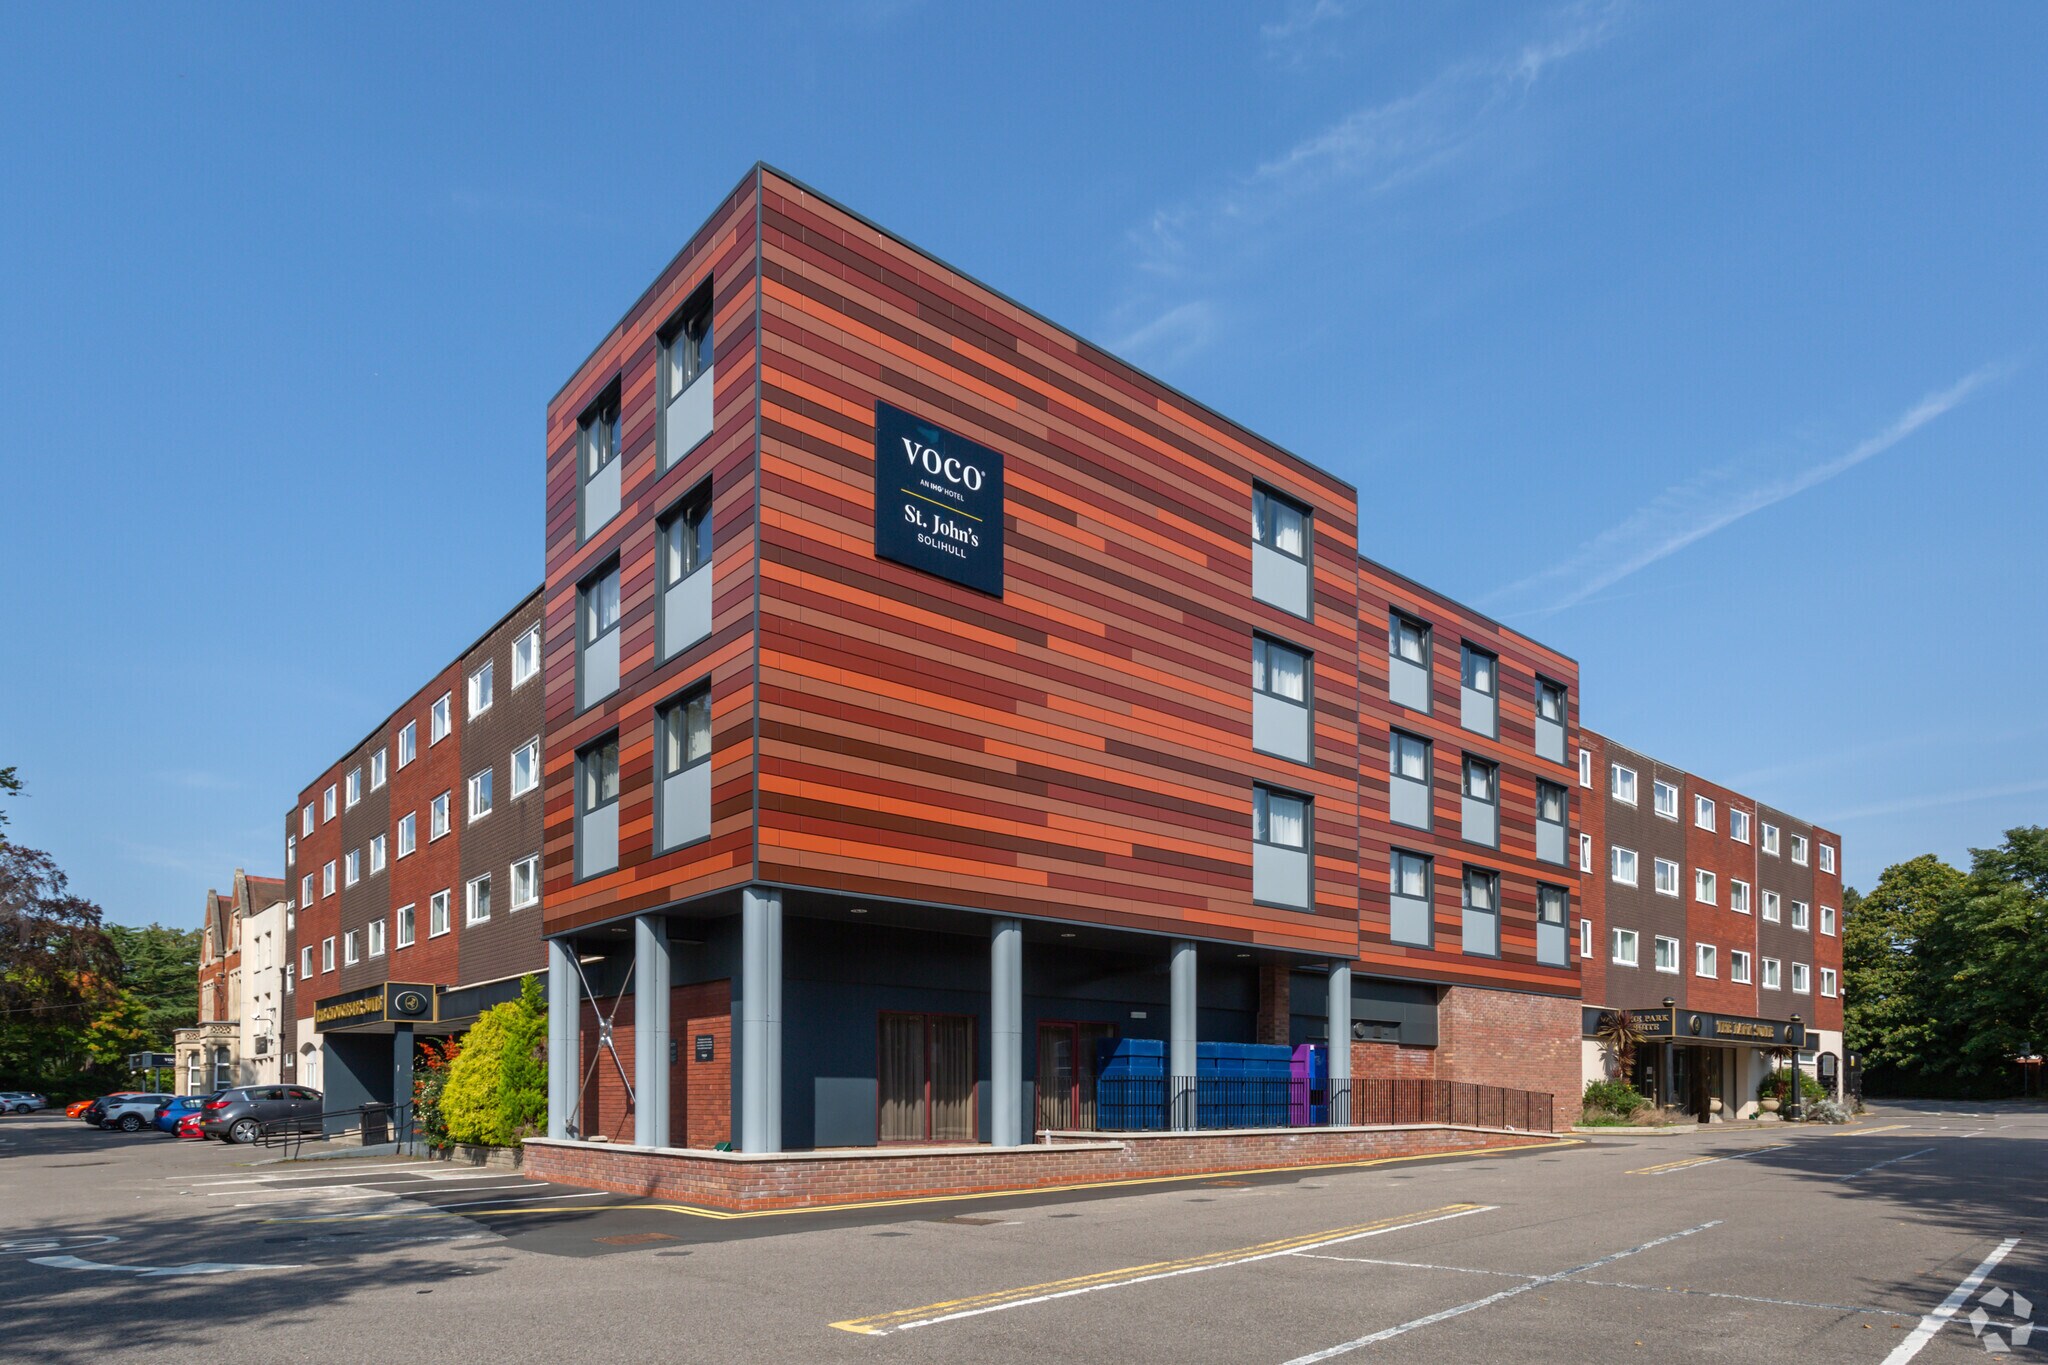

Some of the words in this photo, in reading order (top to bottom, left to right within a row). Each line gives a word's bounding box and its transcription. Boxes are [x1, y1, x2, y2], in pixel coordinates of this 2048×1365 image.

[901, 437, 982, 491] VOCO
[920, 479, 930, 488] AN
[944, 487, 964, 502] HOTEL
[904, 504, 927, 528] St.
[932, 514, 979, 547] John's
[917, 533, 966, 558] SOLIHULL
[1644, 1014, 1669, 1022] PARK
[1716, 1020, 1732, 1033] THE
